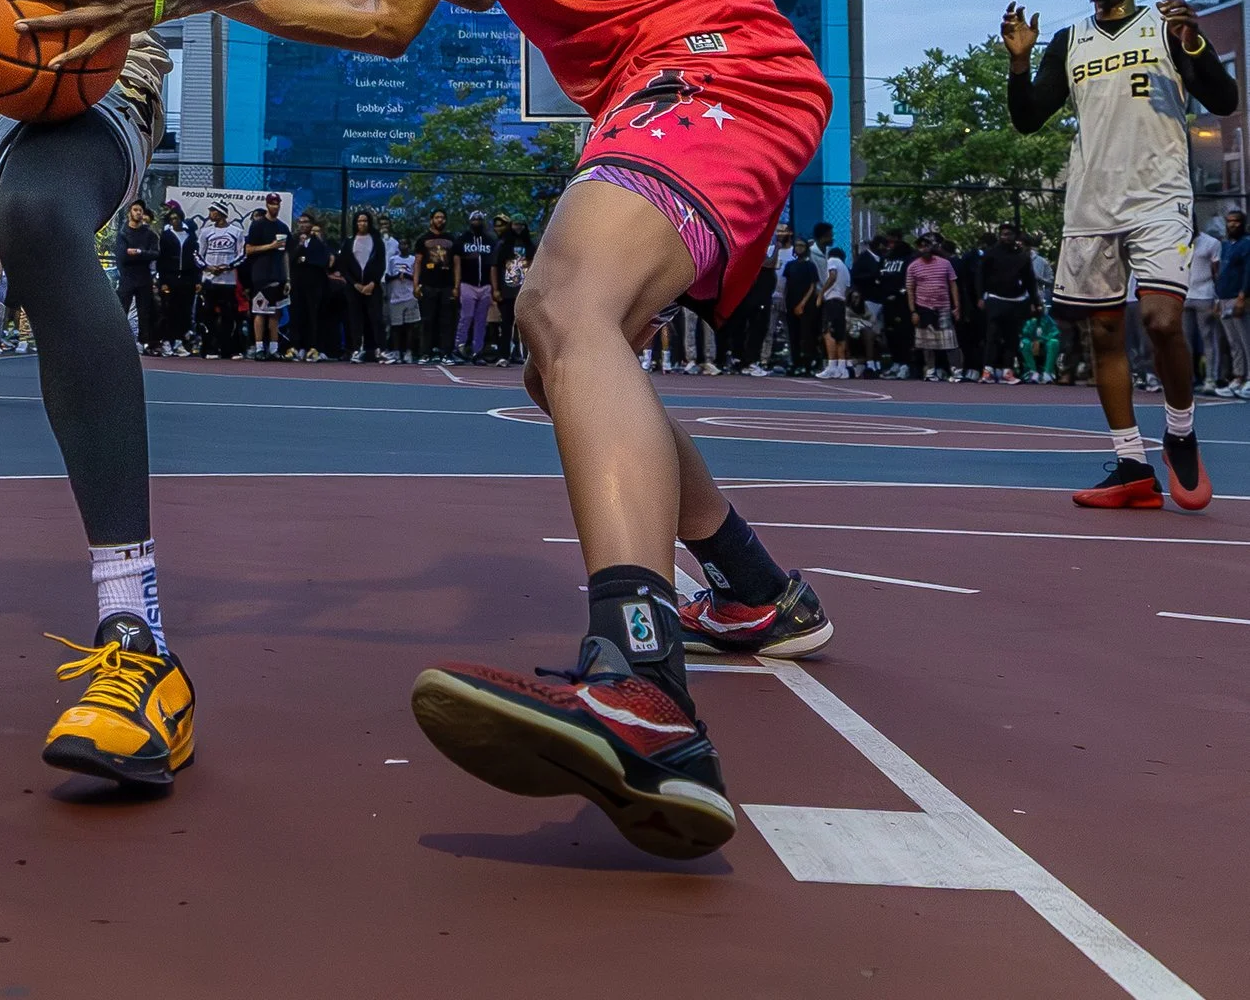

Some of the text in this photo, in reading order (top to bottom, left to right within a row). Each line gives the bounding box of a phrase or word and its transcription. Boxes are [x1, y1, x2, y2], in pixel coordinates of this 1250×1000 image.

[1072, 48, 1159, 84] SSCBL
[355, 78, 377, 87] Luke
[1131, 72, 1150, 98] 2
[342, 129, 387, 139] Alexander
[351, 155, 383, 164] Marcus
